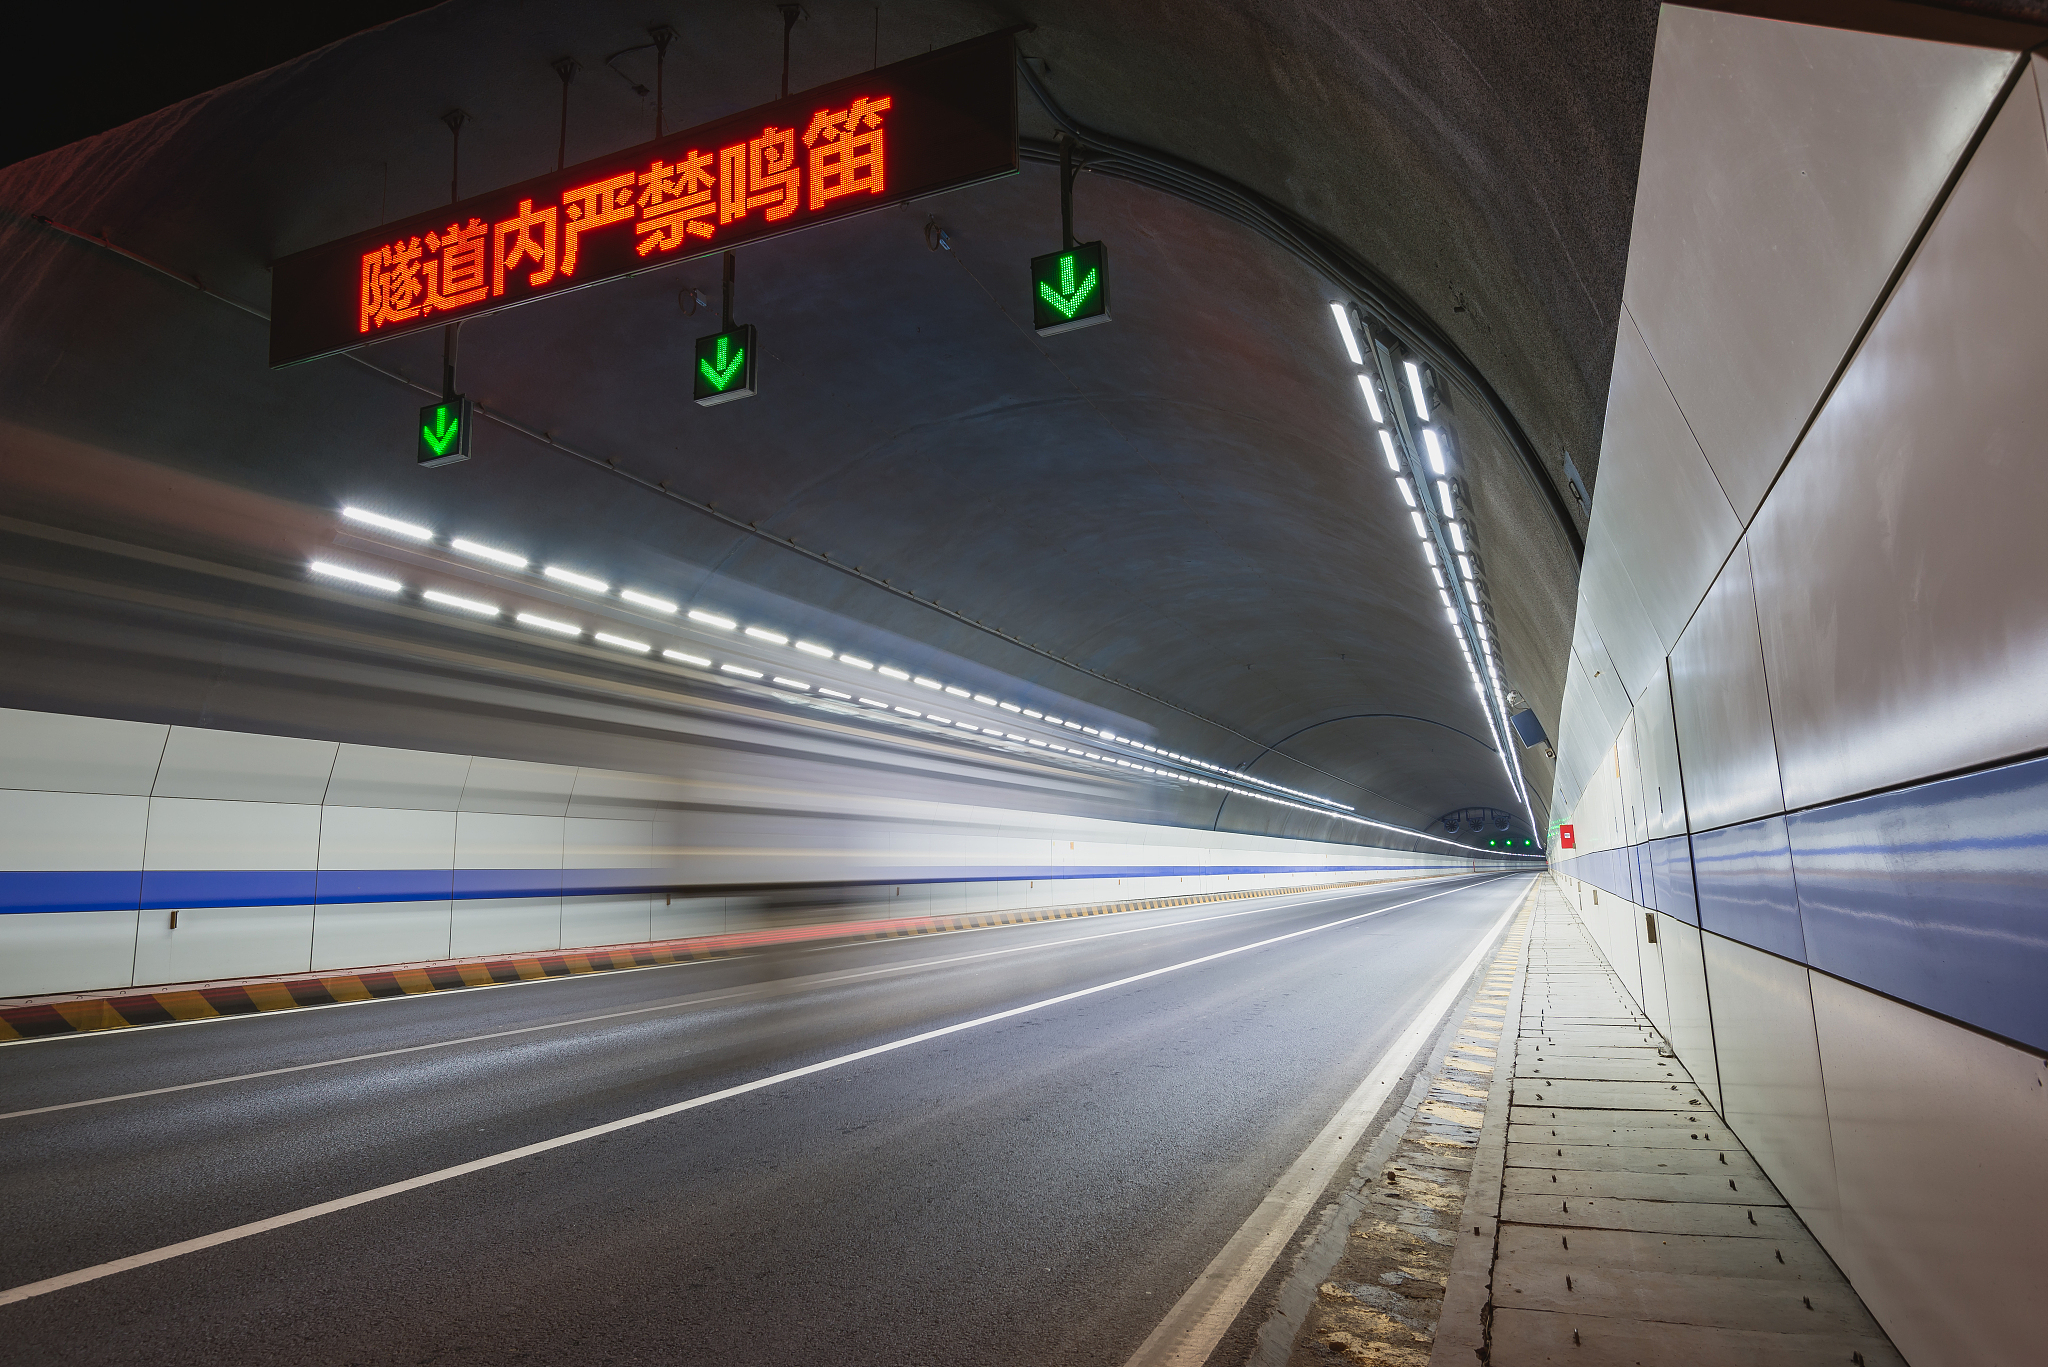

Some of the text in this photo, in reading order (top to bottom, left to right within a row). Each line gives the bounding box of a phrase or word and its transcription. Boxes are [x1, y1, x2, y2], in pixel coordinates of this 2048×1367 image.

[360, 96, 892, 333] 隧道内严禁鸣笛
